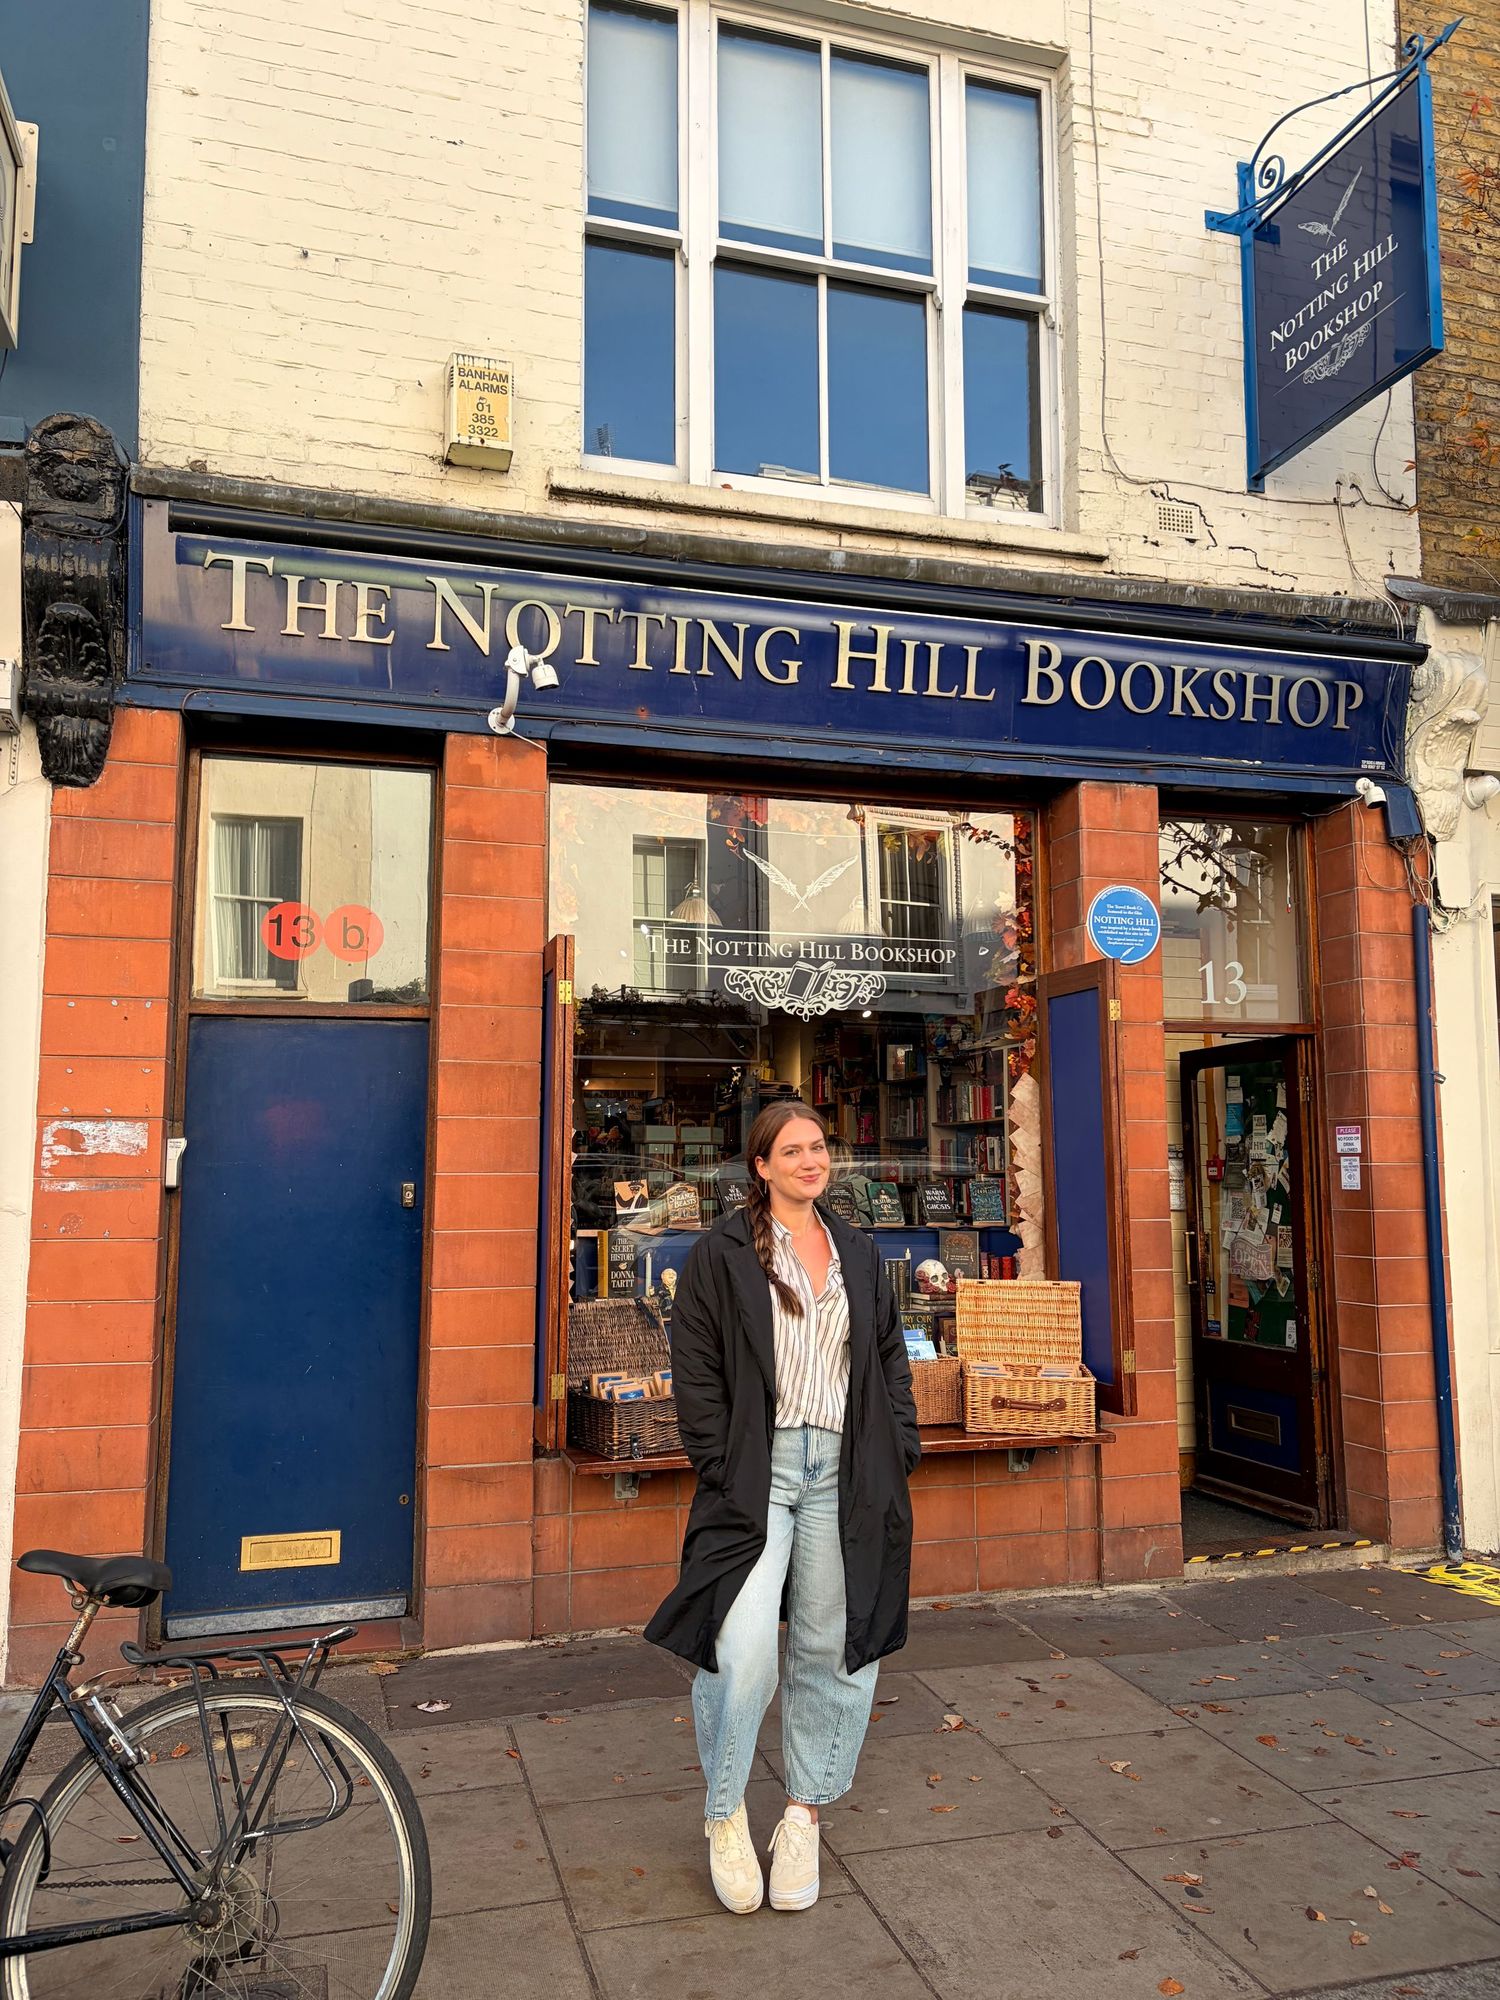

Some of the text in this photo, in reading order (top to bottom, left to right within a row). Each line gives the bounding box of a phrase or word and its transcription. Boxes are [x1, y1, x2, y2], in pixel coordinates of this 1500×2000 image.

[1311, 238, 1348, 281] THE
[1270, 233, 1399, 351] NOTTING HILL
[1284, 280, 1383, 373] BOOKSHOP
[458, 367, 509, 383] BANHAM
[459, 380, 508, 395] ALARMS
[472, 413, 495, 425] 385
[468, 425, 499, 438] 3322
[204, 548, 1364, 730] THE NOTTING HILL BOOKSHOP
[1094, 916, 1156, 926] NOTTING HILL
[269, 914, 364, 949] 13 b
[646, 934, 957, 964] THE NOTTING HILL BOOKSHOP
[1198, 960, 1247, 1005] 13
[611, 1244, 635, 1253] SECRET
[618, 1237, 628, 1245] THE
[610, 1253, 635, 1261] HISTORY
[611, 1270, 635, 1279] DONNA
[611, 1279, 635, 1288] TARTT
